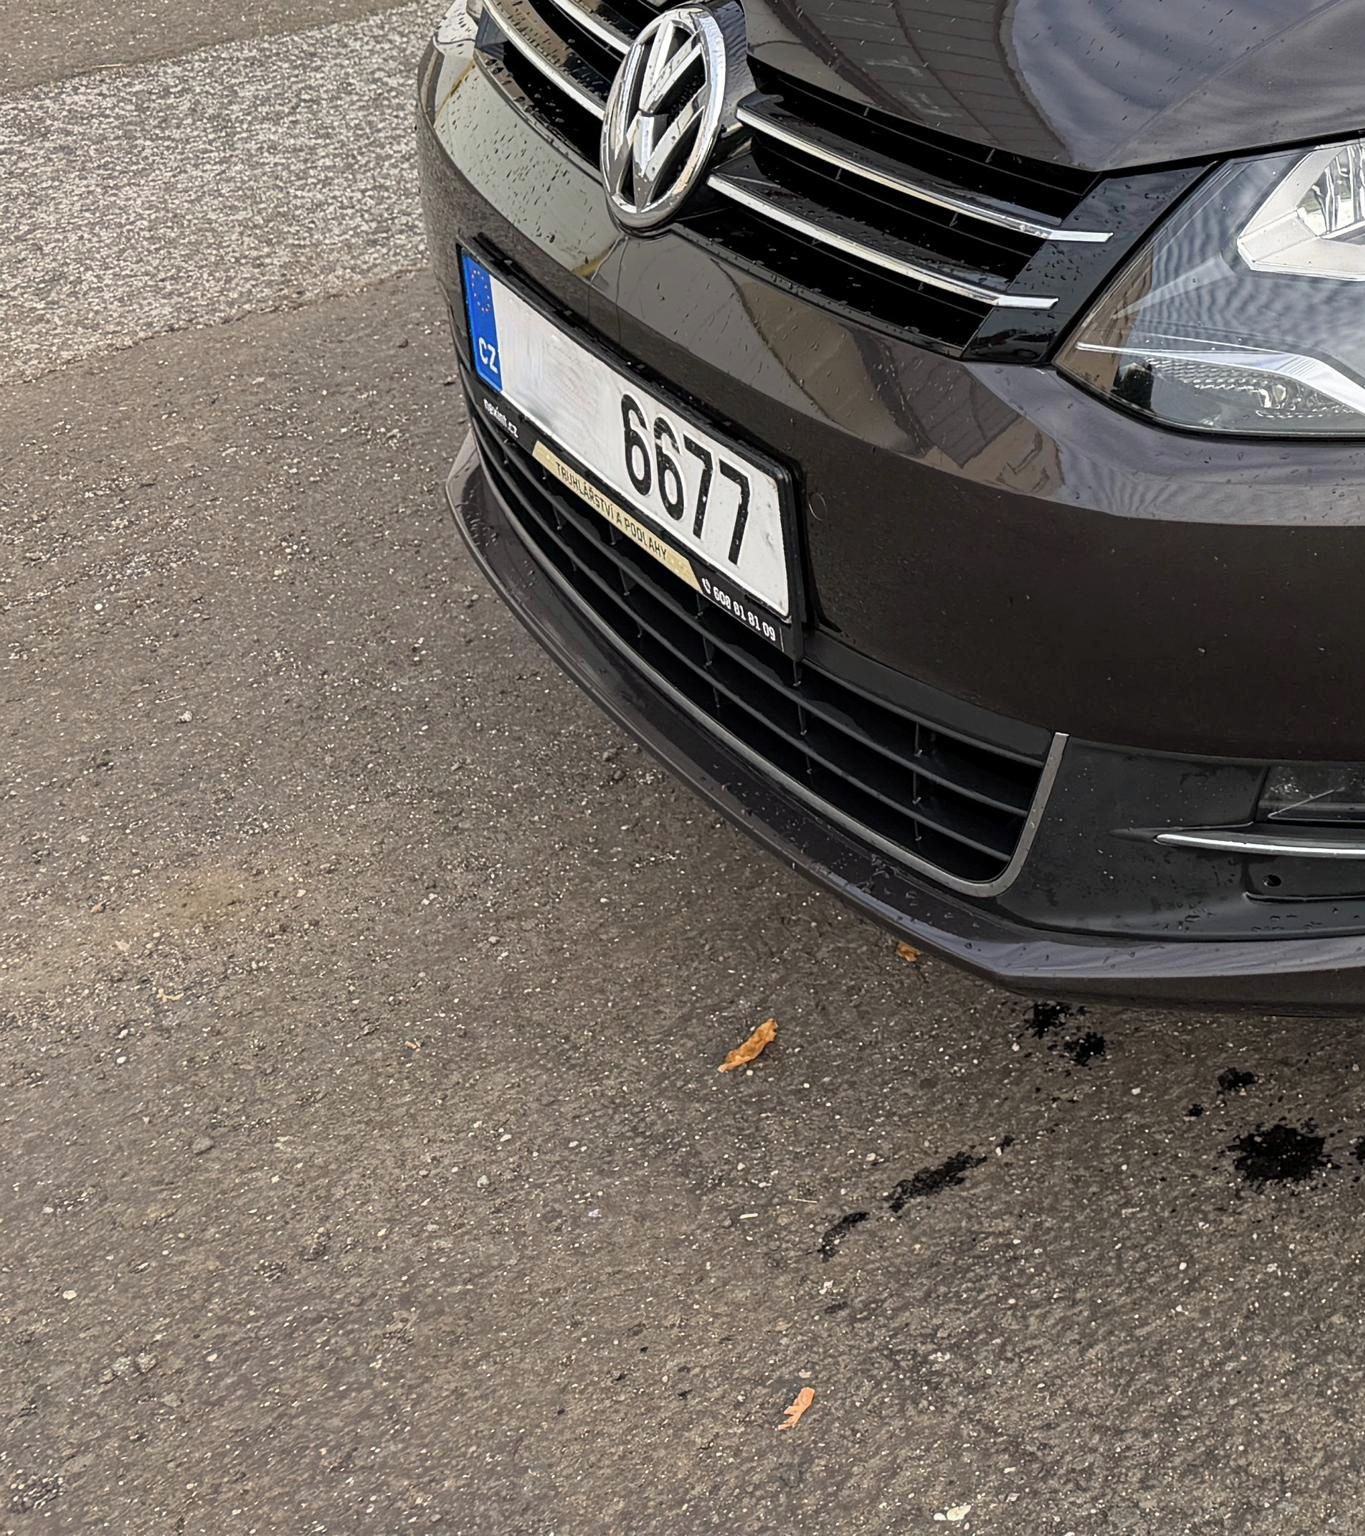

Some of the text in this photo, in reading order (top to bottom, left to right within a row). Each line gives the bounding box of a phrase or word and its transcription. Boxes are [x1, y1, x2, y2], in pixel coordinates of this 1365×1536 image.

[600, 6, 727, 215] VW
[477, 336, 499, 374] CZ
[620, 393, 752, 567] 6677
[616, 512, 623, 525] A
[623, 517, 668, 560] PODLAHY
[733, 601, 747, 621] 81
[747, 611, 761, 631] 81
[762, 621, 776, 642] 09
